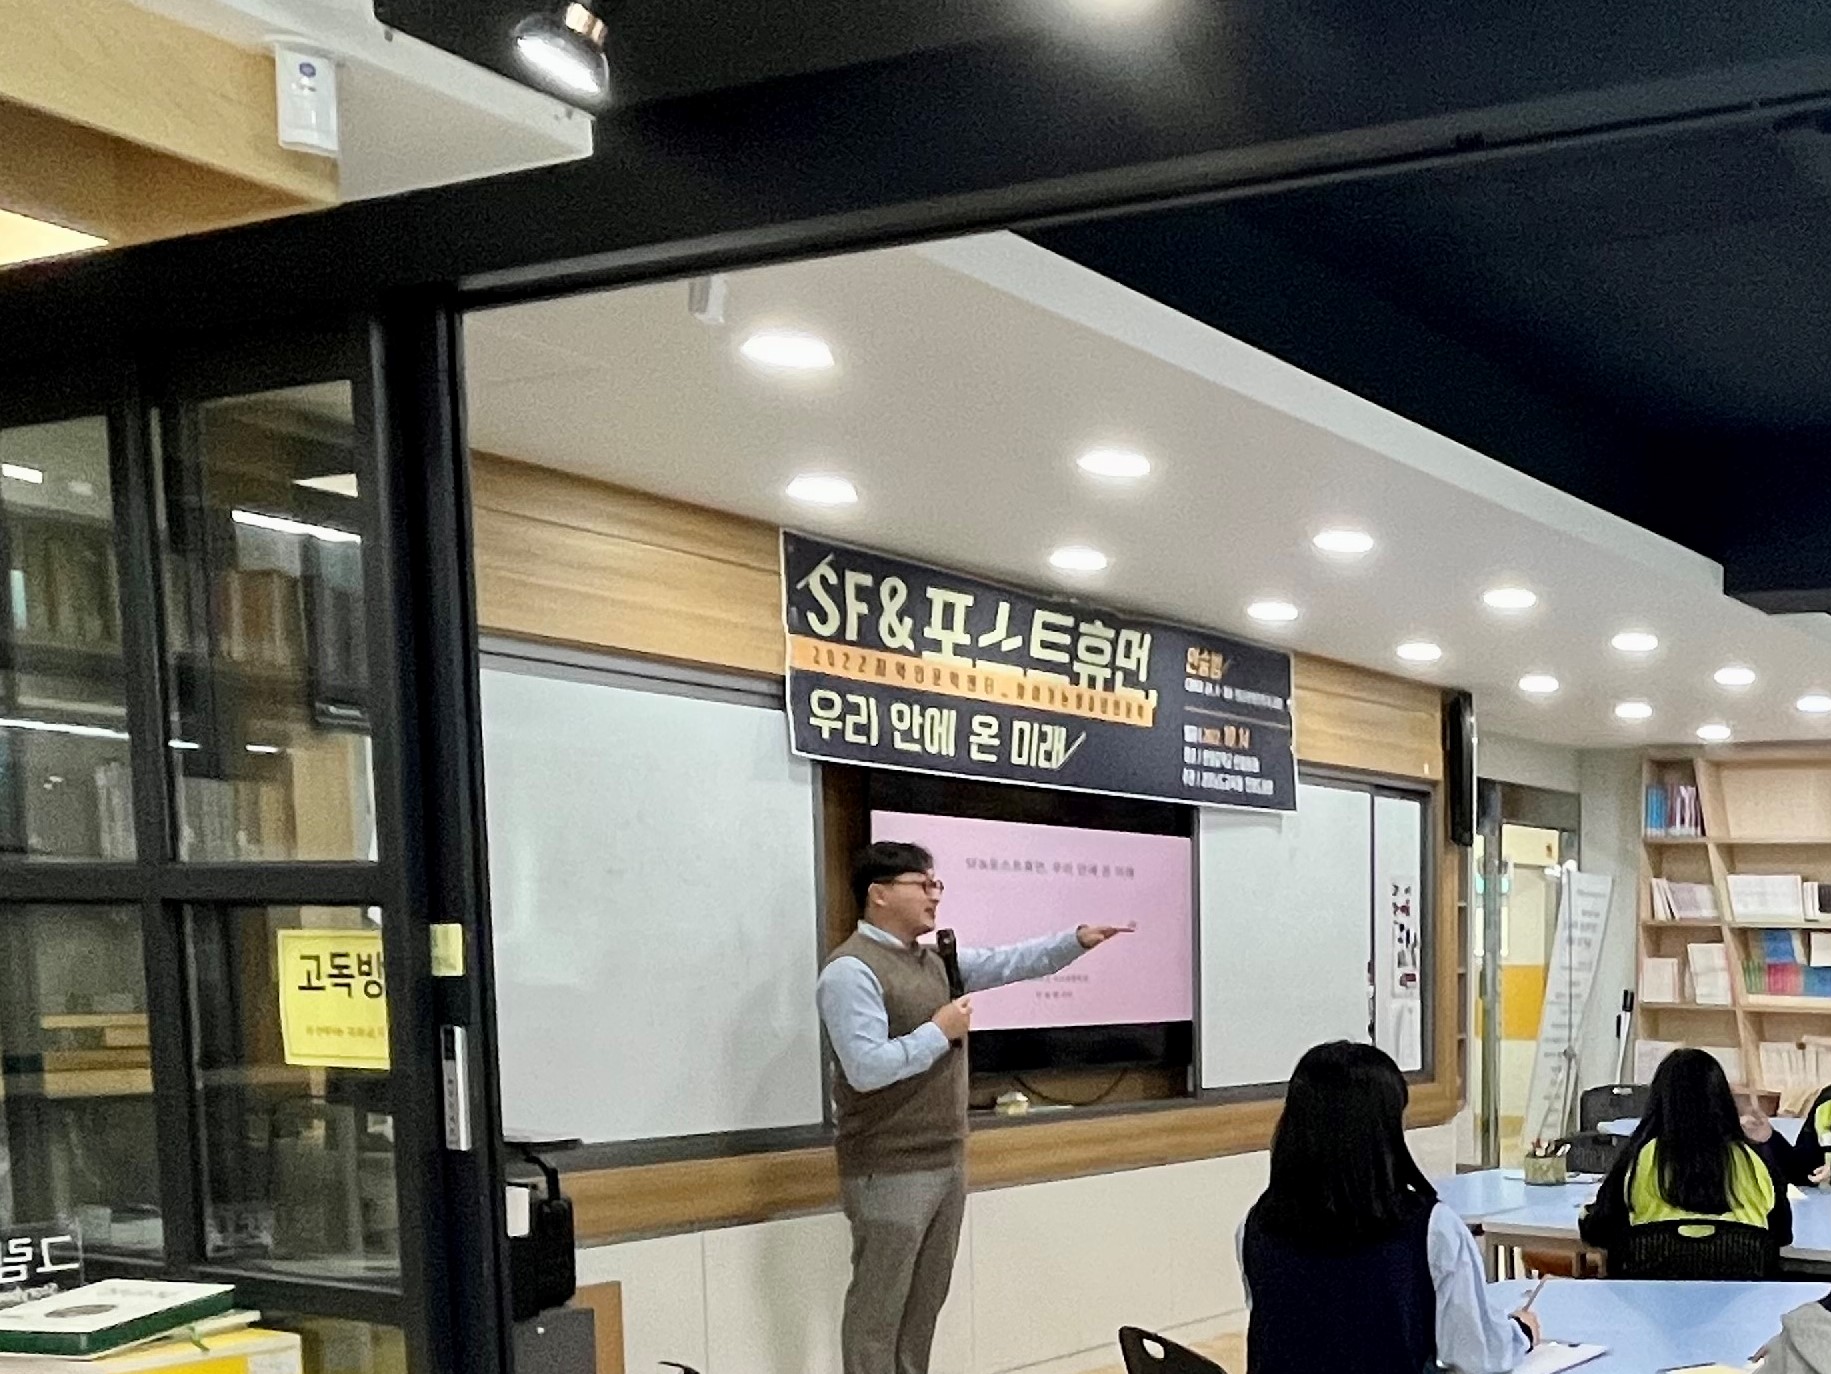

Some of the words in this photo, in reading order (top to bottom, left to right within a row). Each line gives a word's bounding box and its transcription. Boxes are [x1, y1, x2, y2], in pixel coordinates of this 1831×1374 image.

[797, 553, 1159, 708] SF&포스트휴먼
[810, 688, 879, 747] 우리
[890, 702, 957, 758] 안에
[969, 713, 1001, 764] 온
[1010, 719, 1068, 771] 미래
[298, 951, 385, 998] 고독방
